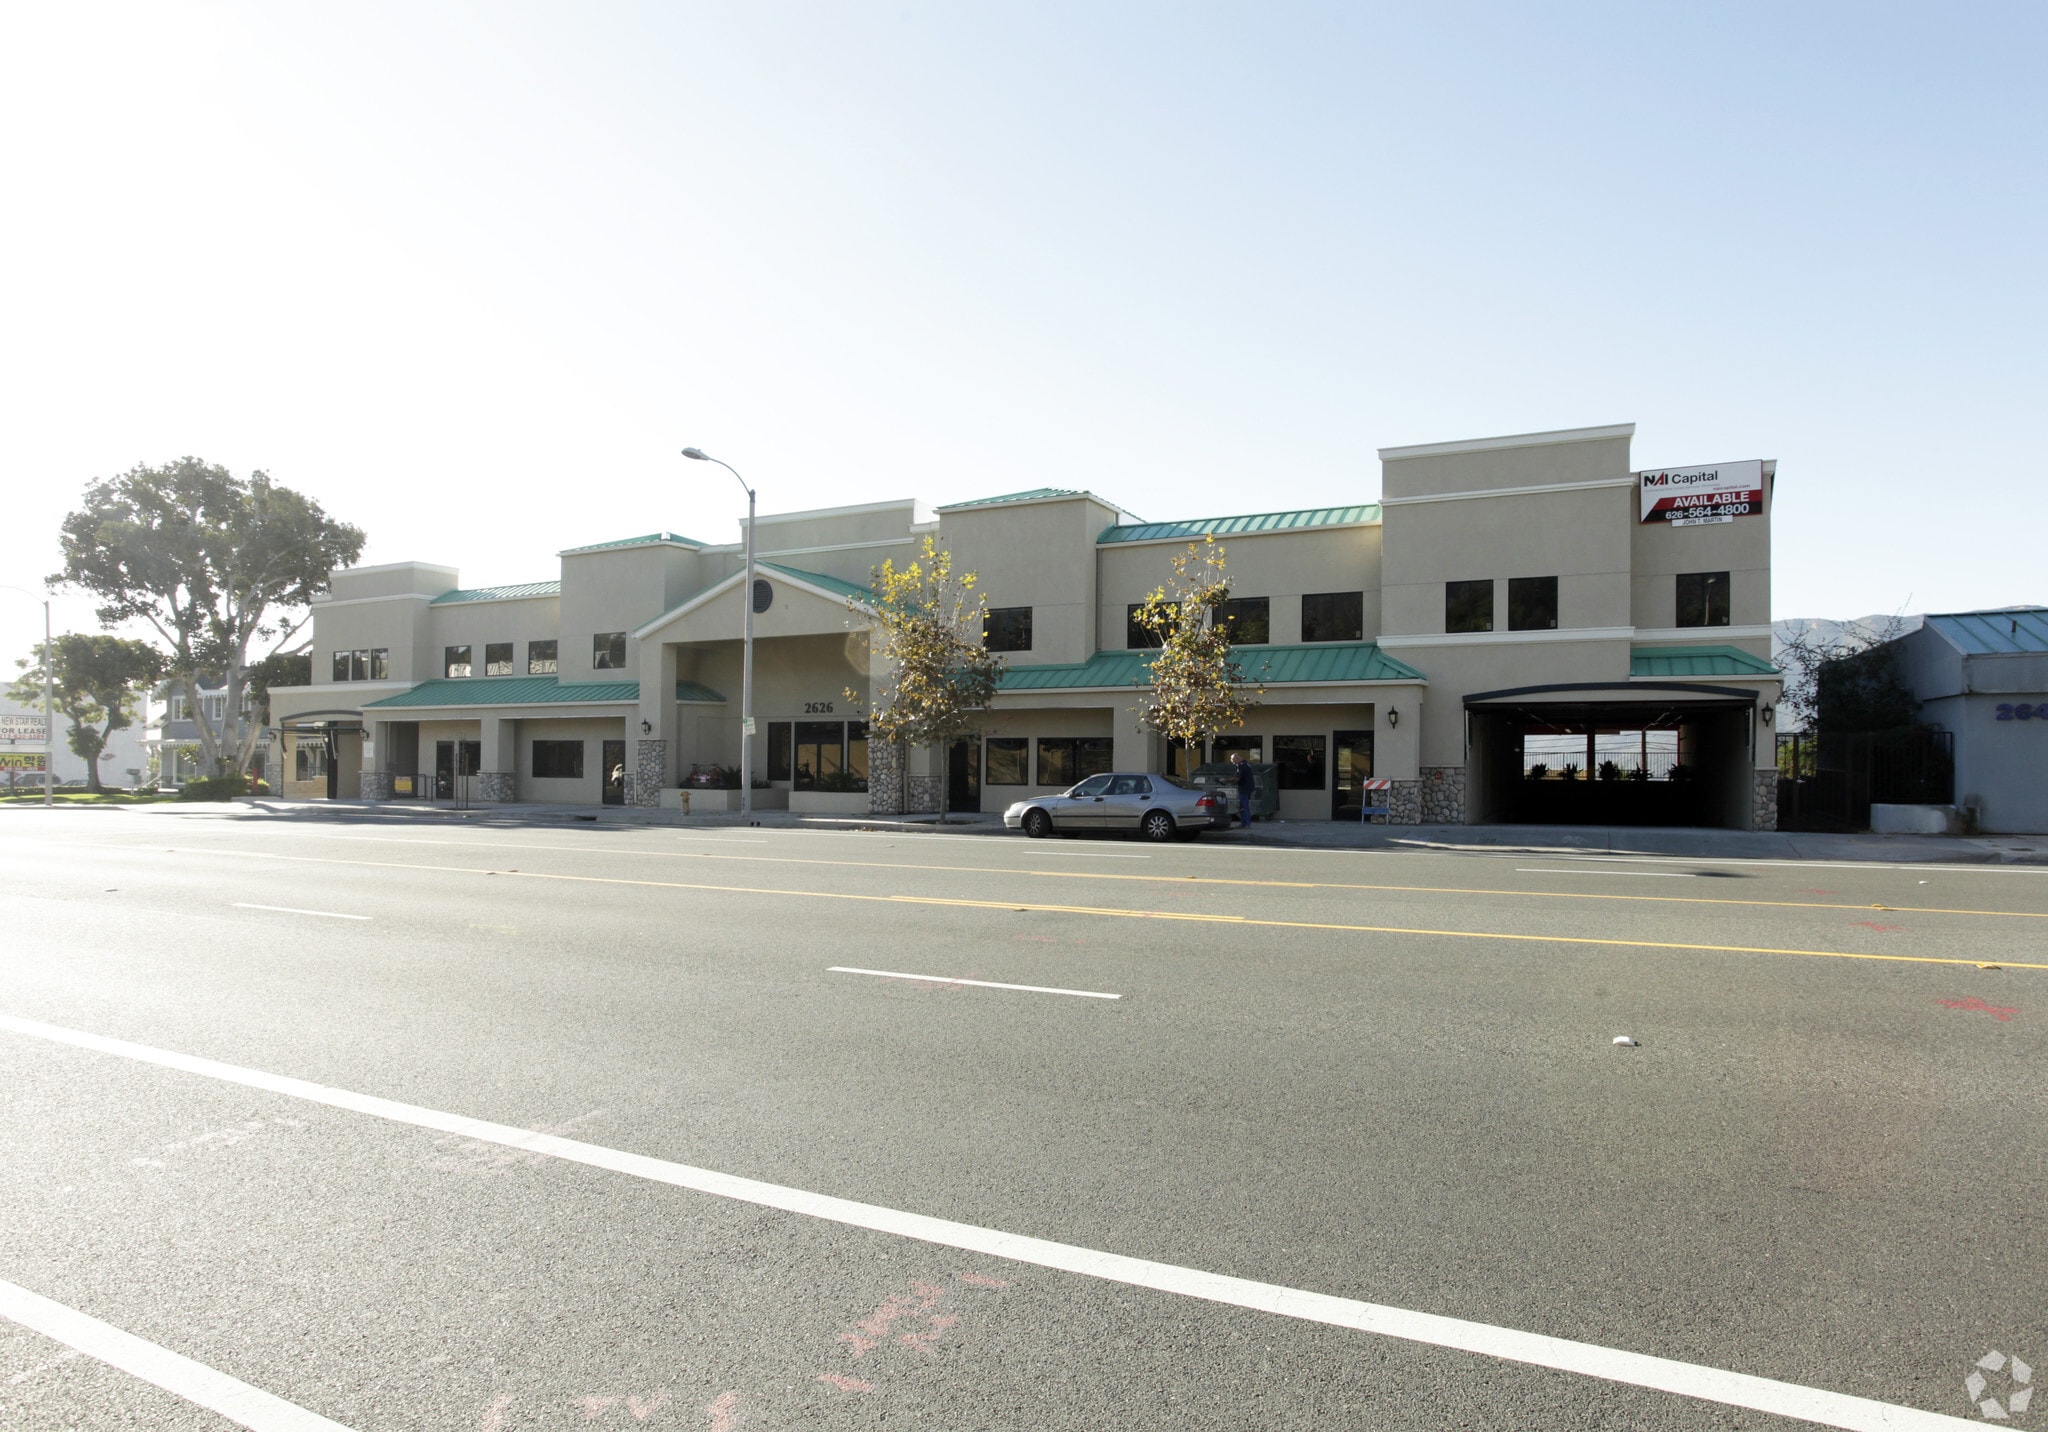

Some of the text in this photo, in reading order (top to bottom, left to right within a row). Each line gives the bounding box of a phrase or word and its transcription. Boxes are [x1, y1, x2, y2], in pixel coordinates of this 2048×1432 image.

[1644, 470, 1718, 487] NAI Capital
[1673, 491, 1750, 508] AVAILABLE
[1665, 503, 1749, 520] 626-564-4800
[1682, 518, 1697, 526] JOHN
[804, 702, 834, 714] 2626
[18, 727, 47, 735] LEASE
